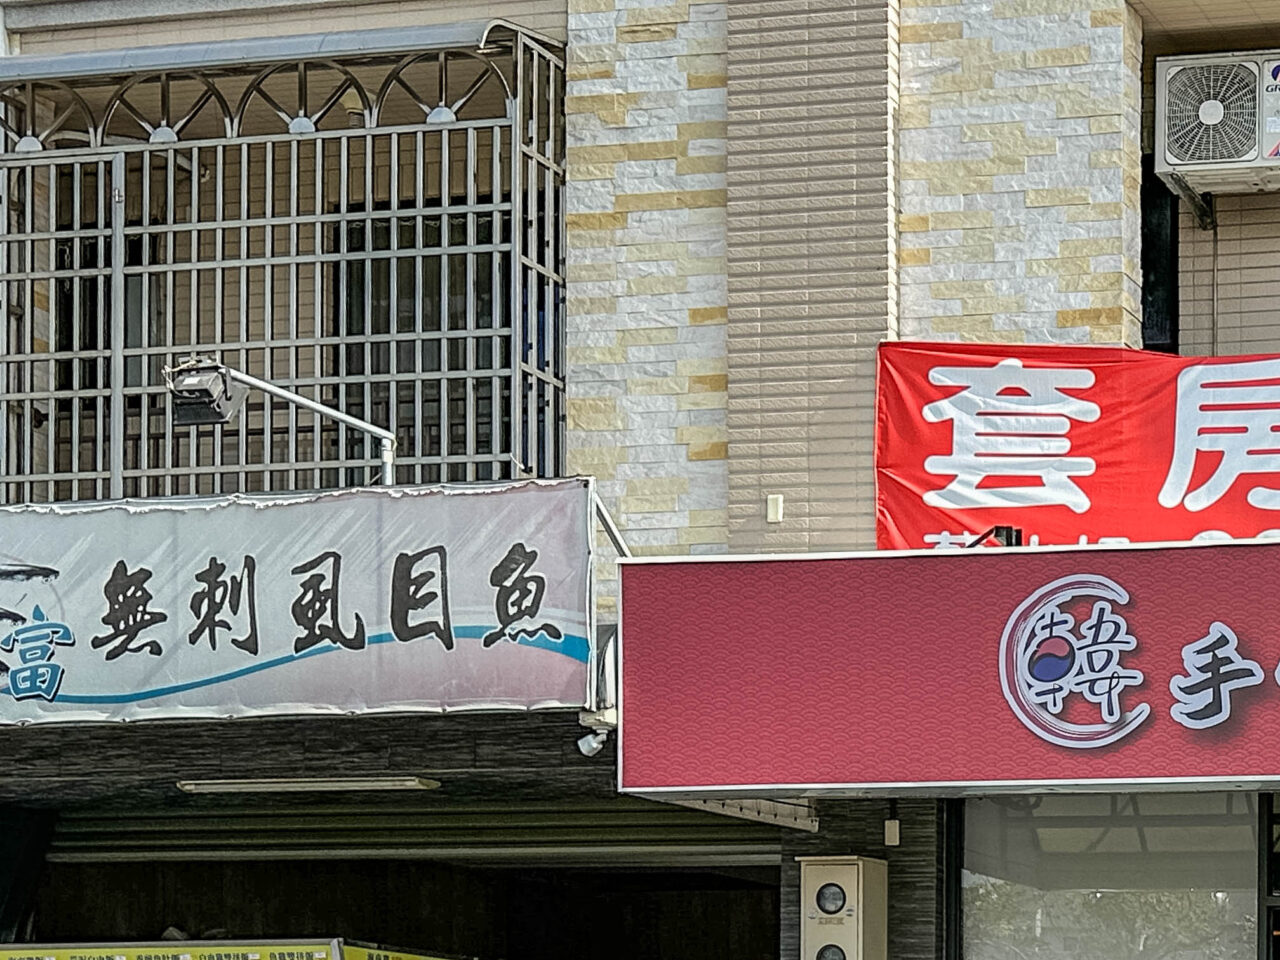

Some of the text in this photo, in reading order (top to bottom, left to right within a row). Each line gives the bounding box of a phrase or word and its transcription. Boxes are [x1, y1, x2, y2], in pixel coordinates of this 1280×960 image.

[90, 542, 563, 661] 無刺虱目魚
